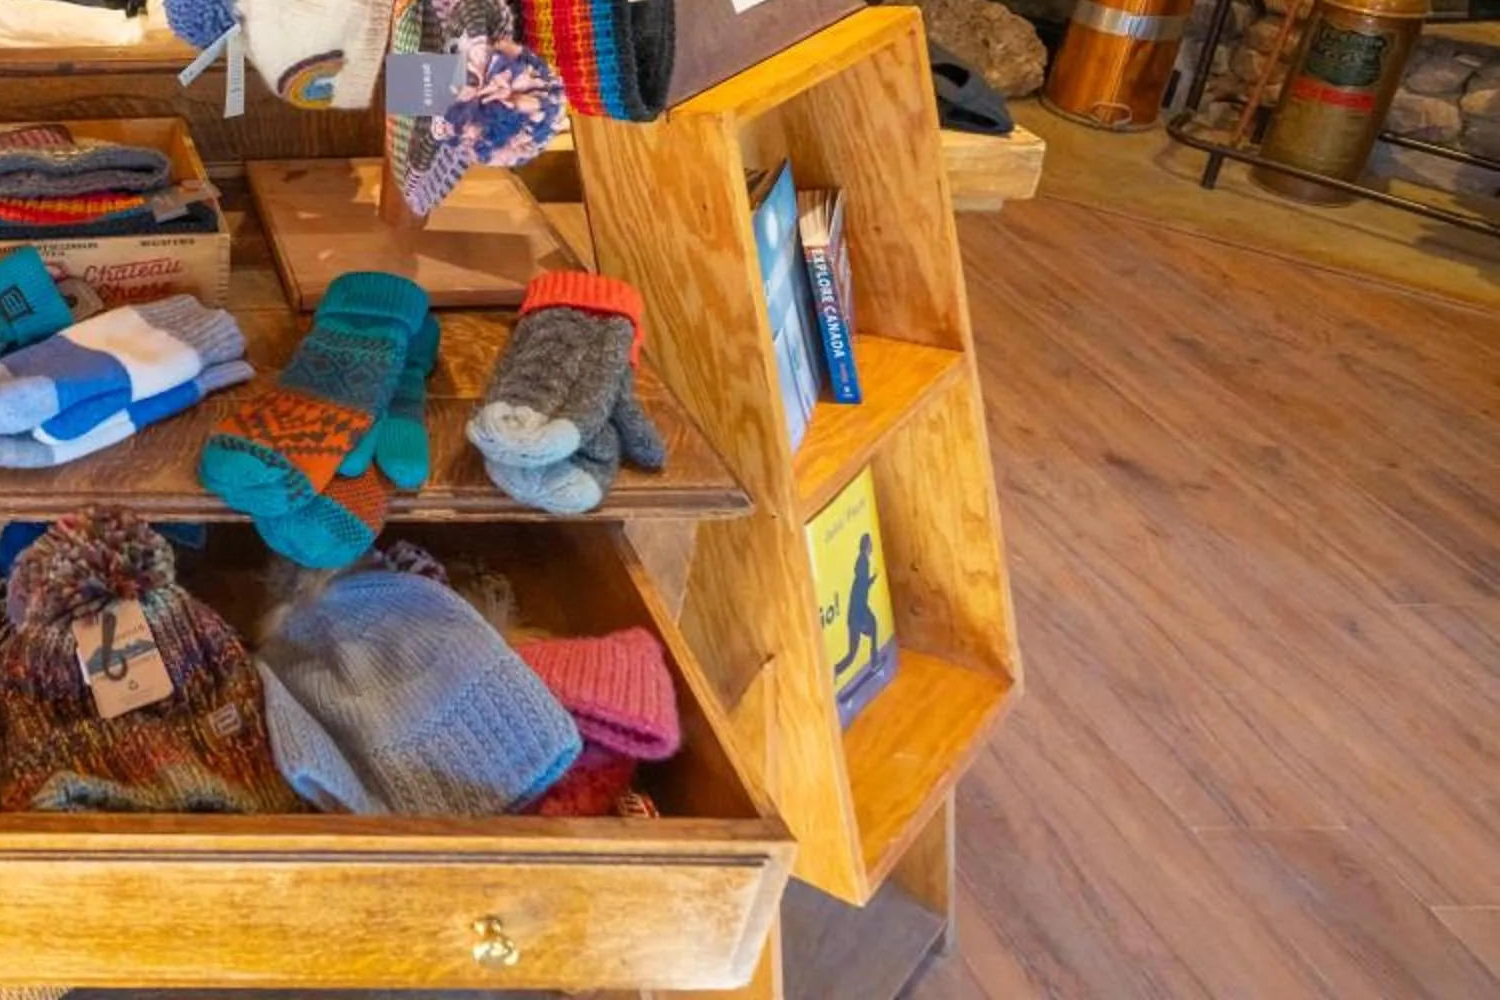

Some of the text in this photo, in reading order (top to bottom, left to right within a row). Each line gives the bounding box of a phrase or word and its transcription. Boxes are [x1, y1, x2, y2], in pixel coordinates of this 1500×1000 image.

[84, 257, 185, 286] Chateau
[812, 249, 836, 304] EXPLORE
[823, 303, 847, 360] CANADA
